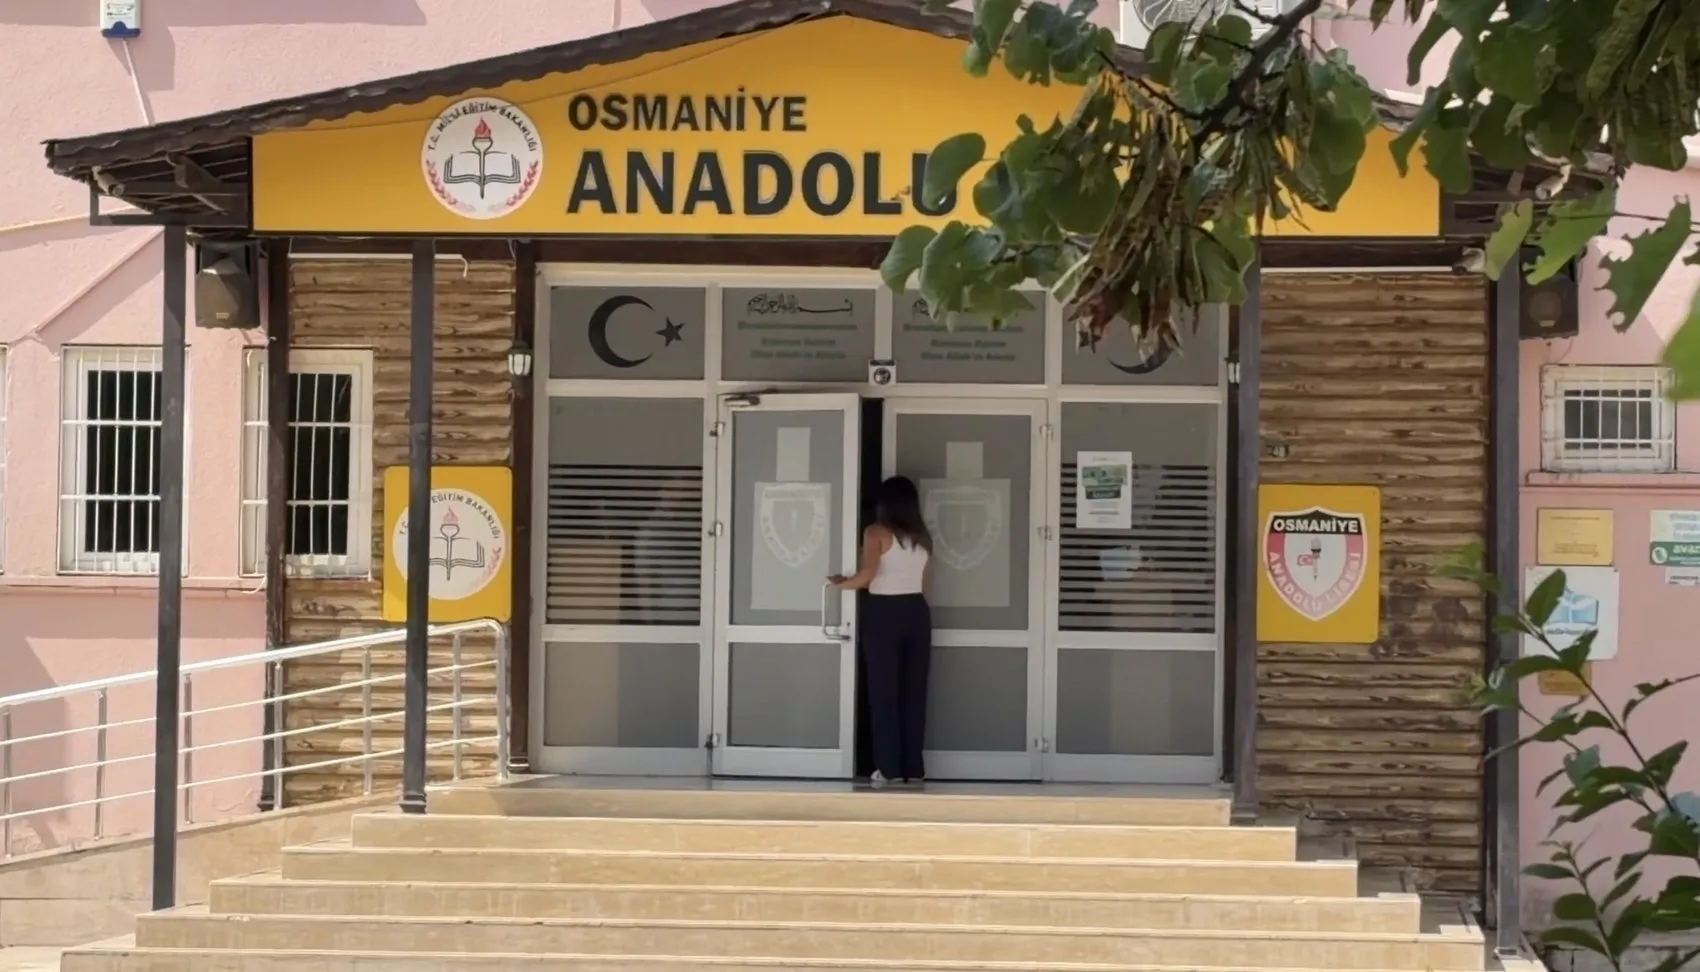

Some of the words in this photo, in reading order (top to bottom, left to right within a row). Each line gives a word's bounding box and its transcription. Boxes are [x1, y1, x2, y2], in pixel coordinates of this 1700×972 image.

[462, 101, 497, 116] EĞİTİM
[567, 85, 808, 132] OSMANİYE
[1273, 518, 1358, 532] OSMANİYE
[1269, 551, 1322, 612] ANADOLU
